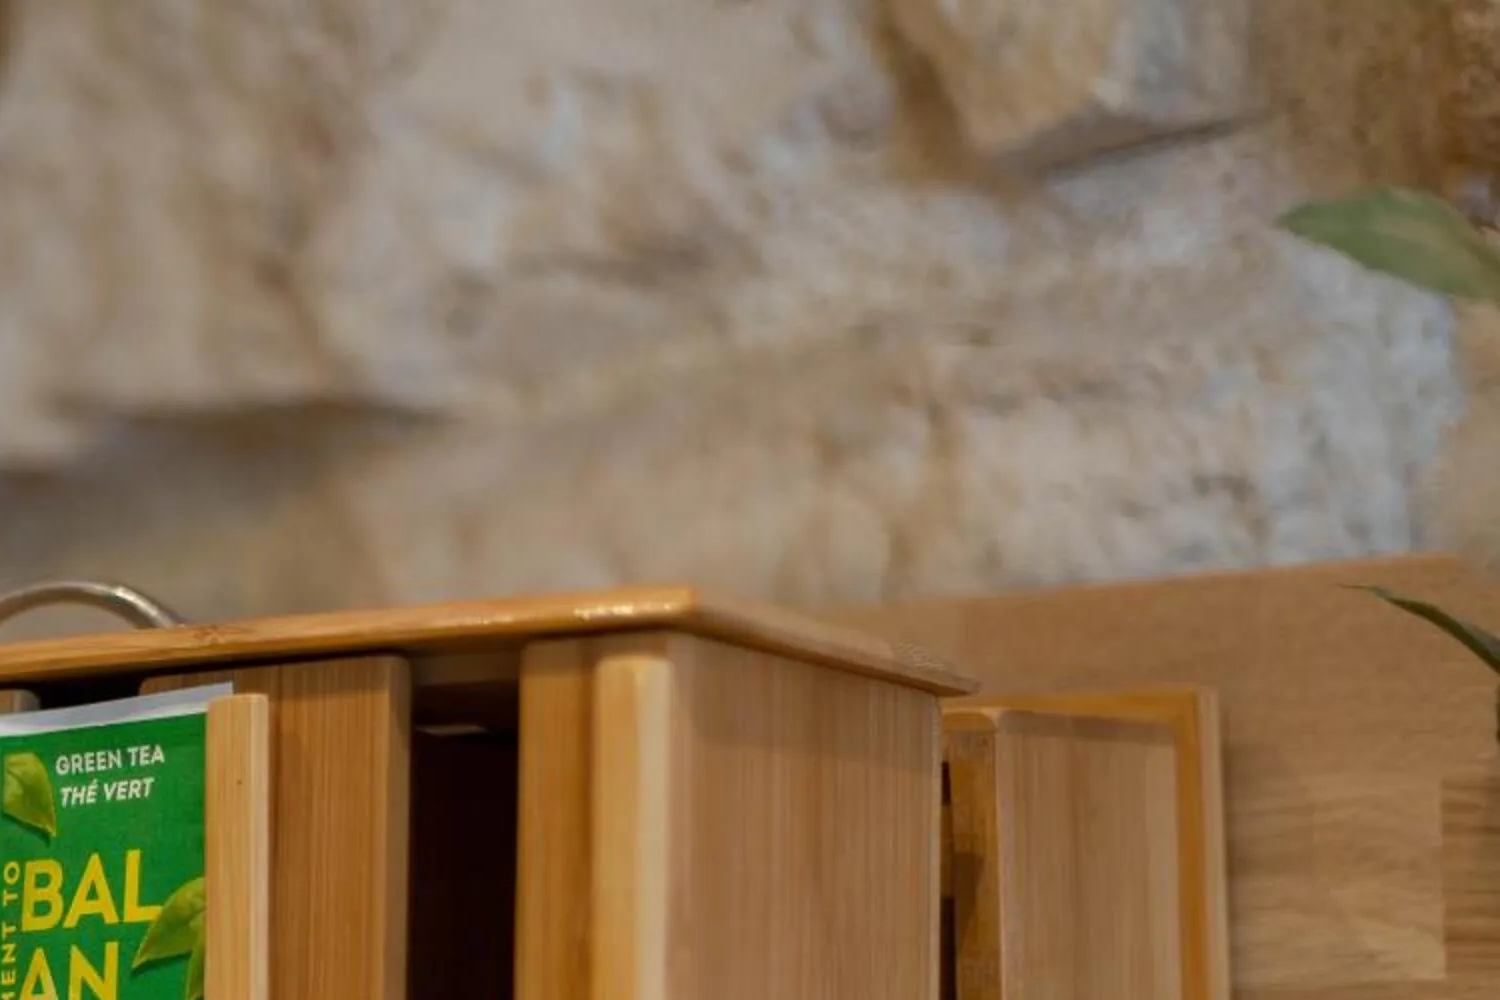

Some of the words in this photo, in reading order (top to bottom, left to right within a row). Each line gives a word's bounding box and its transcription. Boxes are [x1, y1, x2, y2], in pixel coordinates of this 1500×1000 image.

[55, 749, 122, 776] GREEN
[127, 744, 166, 767] TEA
[60, 779, 98, 807] THÉ
[103, 777, 155, 801] VERT
[3, 861, 20, 911] TO
[21, 849, 163, 932] BAL
